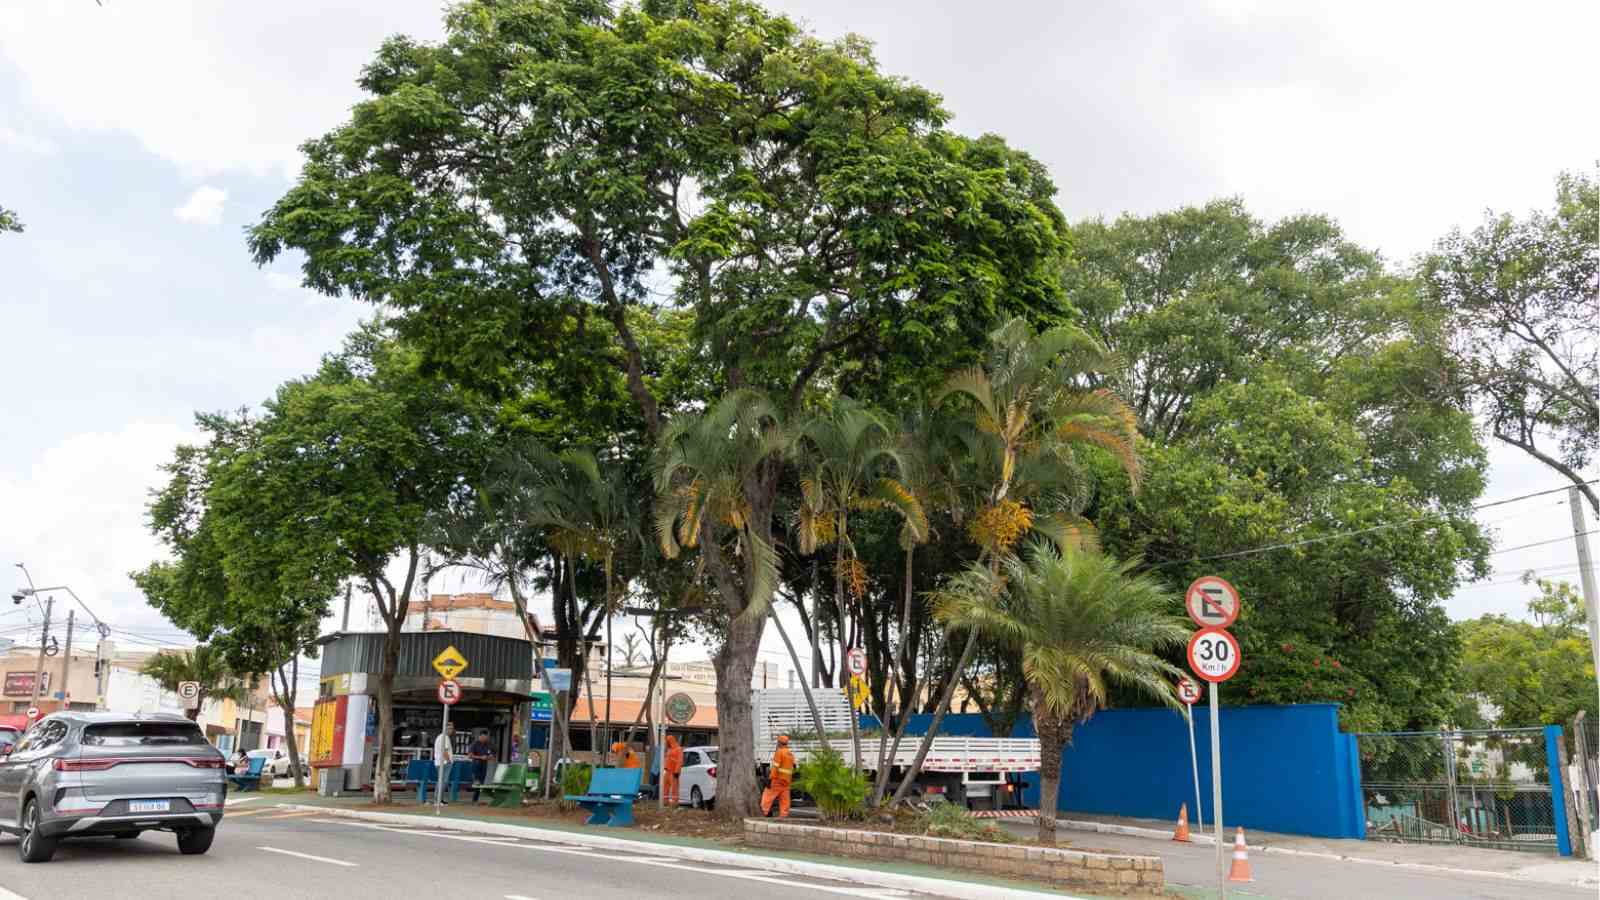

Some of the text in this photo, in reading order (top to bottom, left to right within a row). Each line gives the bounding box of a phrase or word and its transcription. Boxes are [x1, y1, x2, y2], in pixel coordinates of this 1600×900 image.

[1201, 587, 1224, 617] E
[1200, 639, 1228, 661] 30
[184, 685, 193, 696] E
